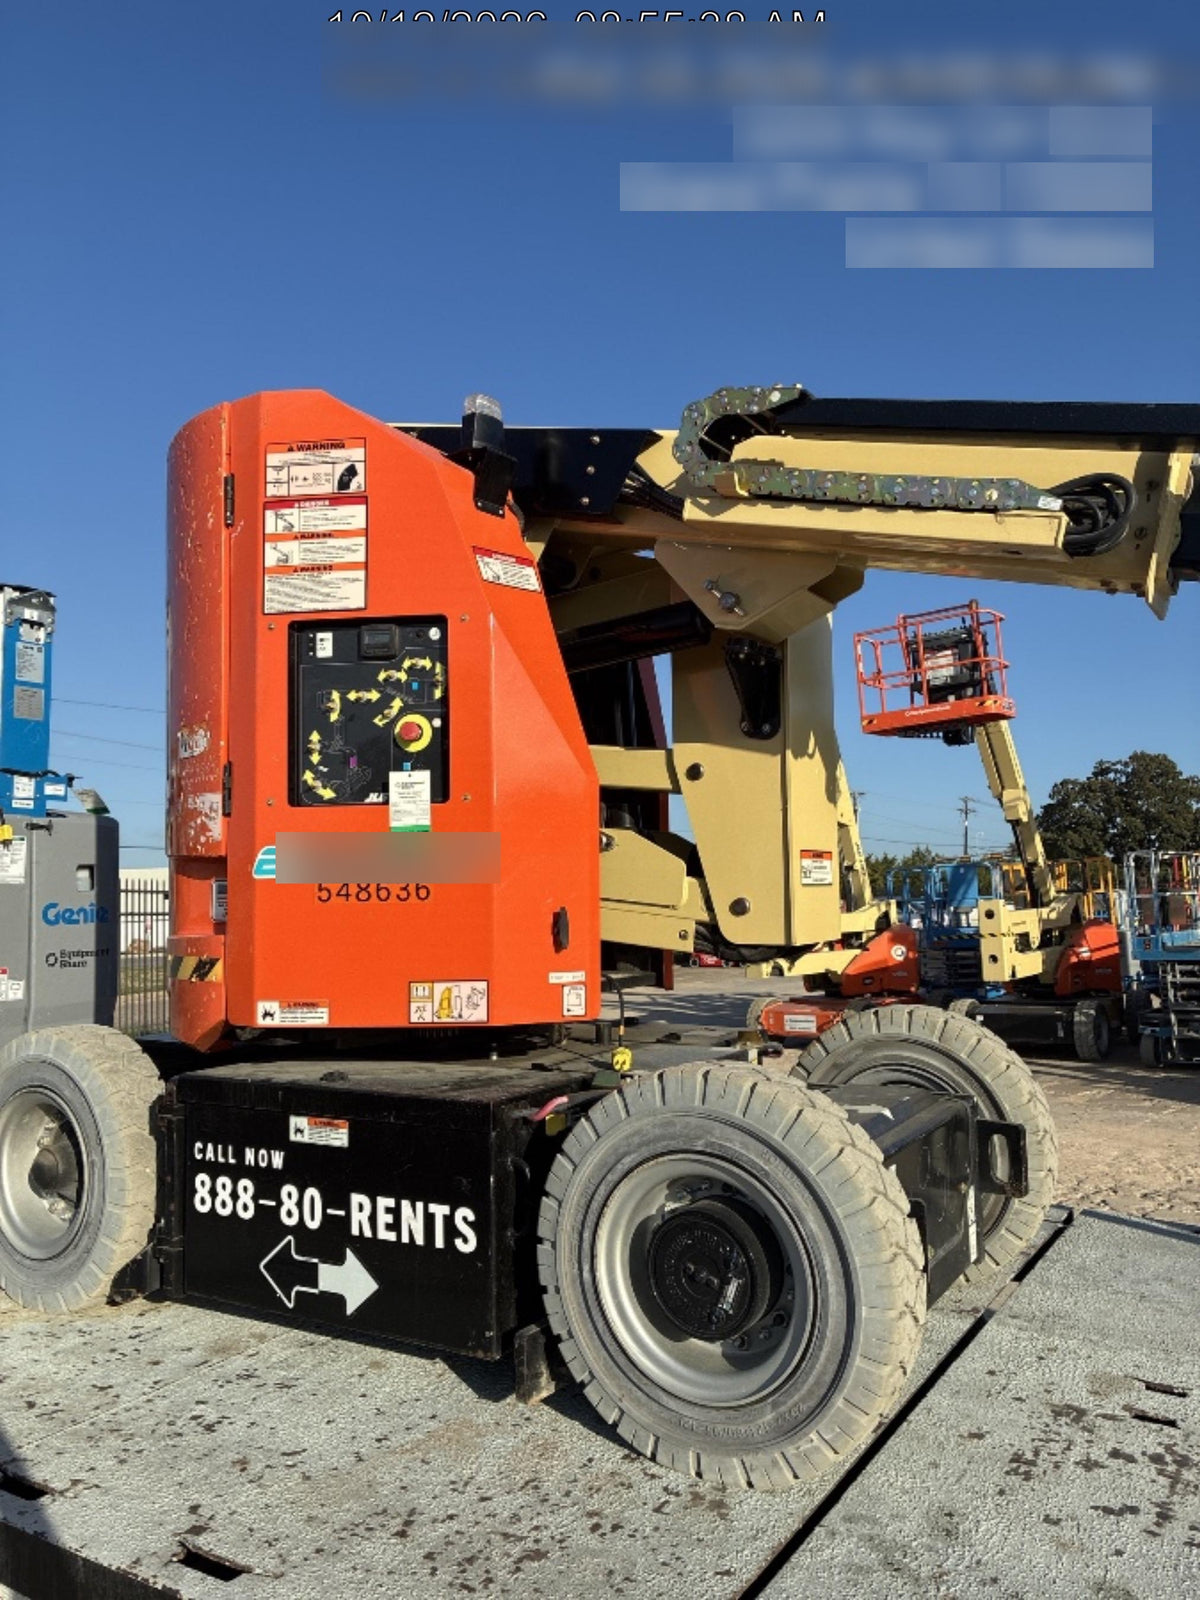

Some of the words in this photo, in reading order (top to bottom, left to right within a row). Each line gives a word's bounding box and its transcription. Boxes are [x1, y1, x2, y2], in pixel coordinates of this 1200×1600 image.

[42, 902, 109, 926] Genie
[193, 1141, 236, 1164] CALL
[244, 1147, 284, 1170] NOW
[193, 1172, 478, 1254] 888-80-RENTS
